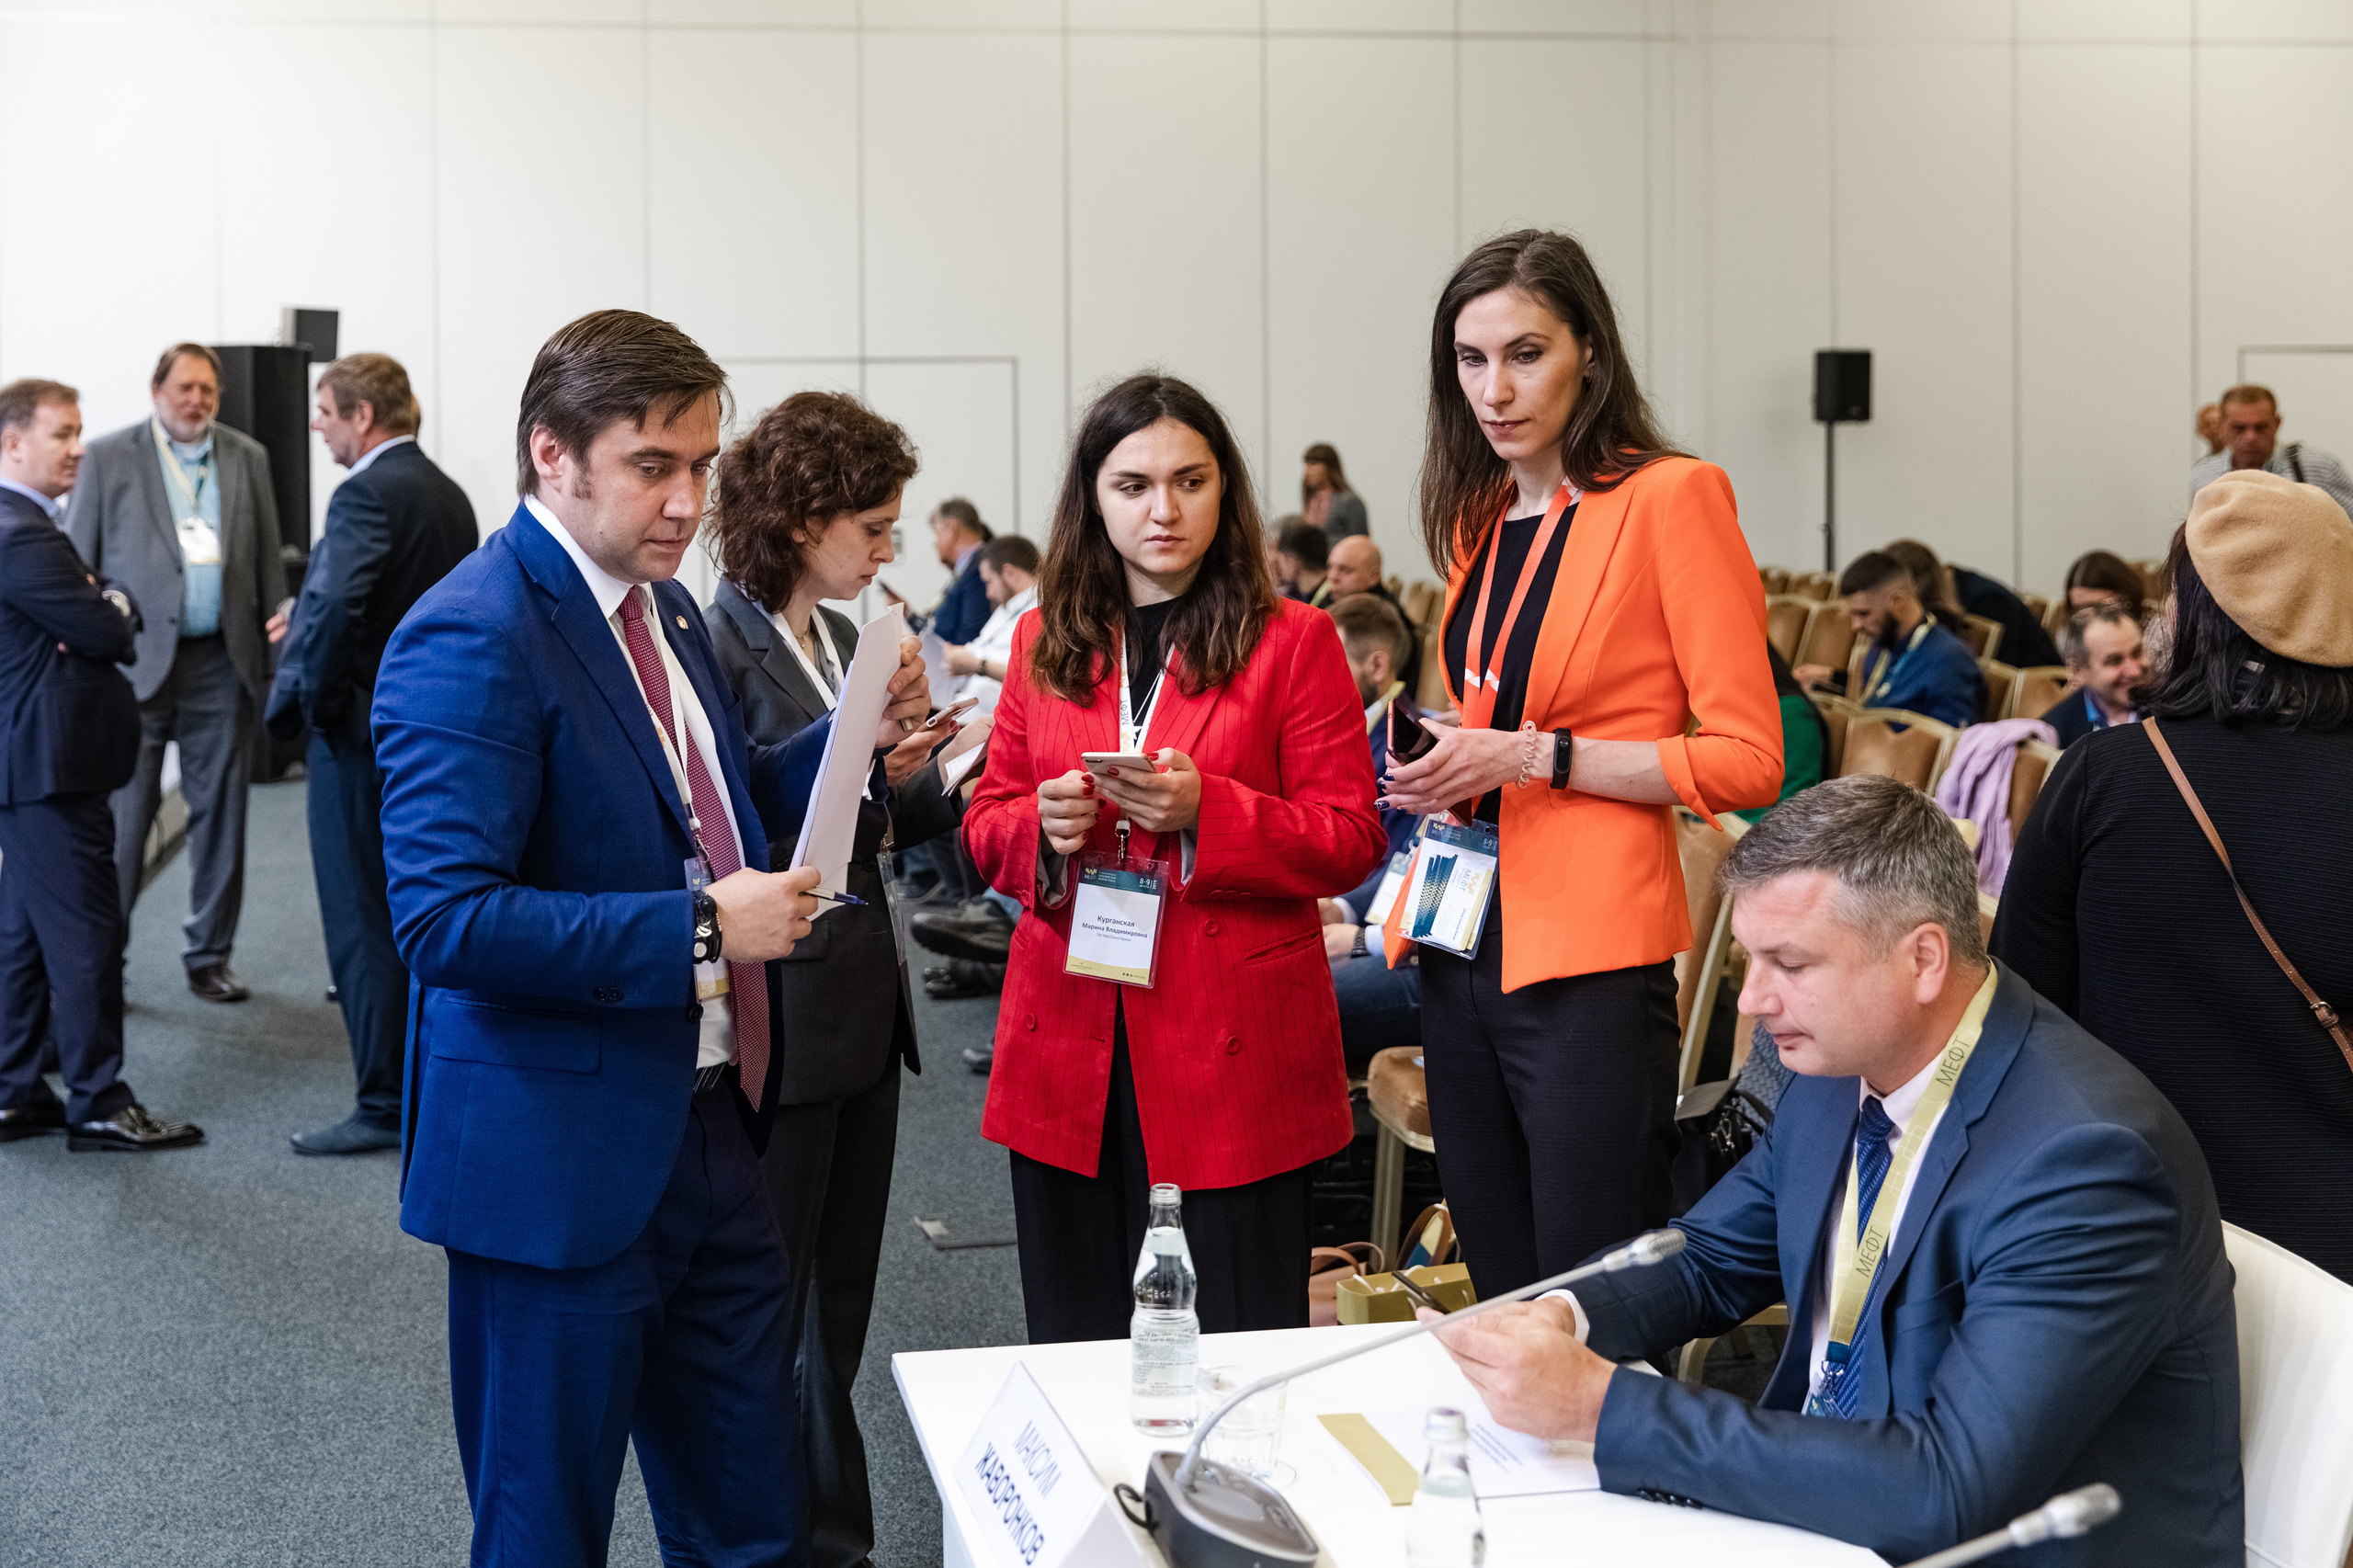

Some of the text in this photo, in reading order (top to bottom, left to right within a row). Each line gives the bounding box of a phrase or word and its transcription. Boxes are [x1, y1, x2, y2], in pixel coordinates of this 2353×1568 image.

[1120, 699, 1130, 725] МЕФТ
[1483, 838, 1493, 846] 8-9
[1139, 878, 1151, 886] 8-9
[1459, 868, 1472, 892] МЕФТ
[1082, 923, 1148, 938] Марина Владимировна
[1097, 915, 1135, 927] Курганская
[1936, 1035, 1970, 1086] МЕФТ
[1856, 1225, 1883, 1278] МЕФТ
[1012, 1419, 1062, 1500] МАКСИМ
[975, 1441, 1045, 1565] ЖАВОРОНКОВ
